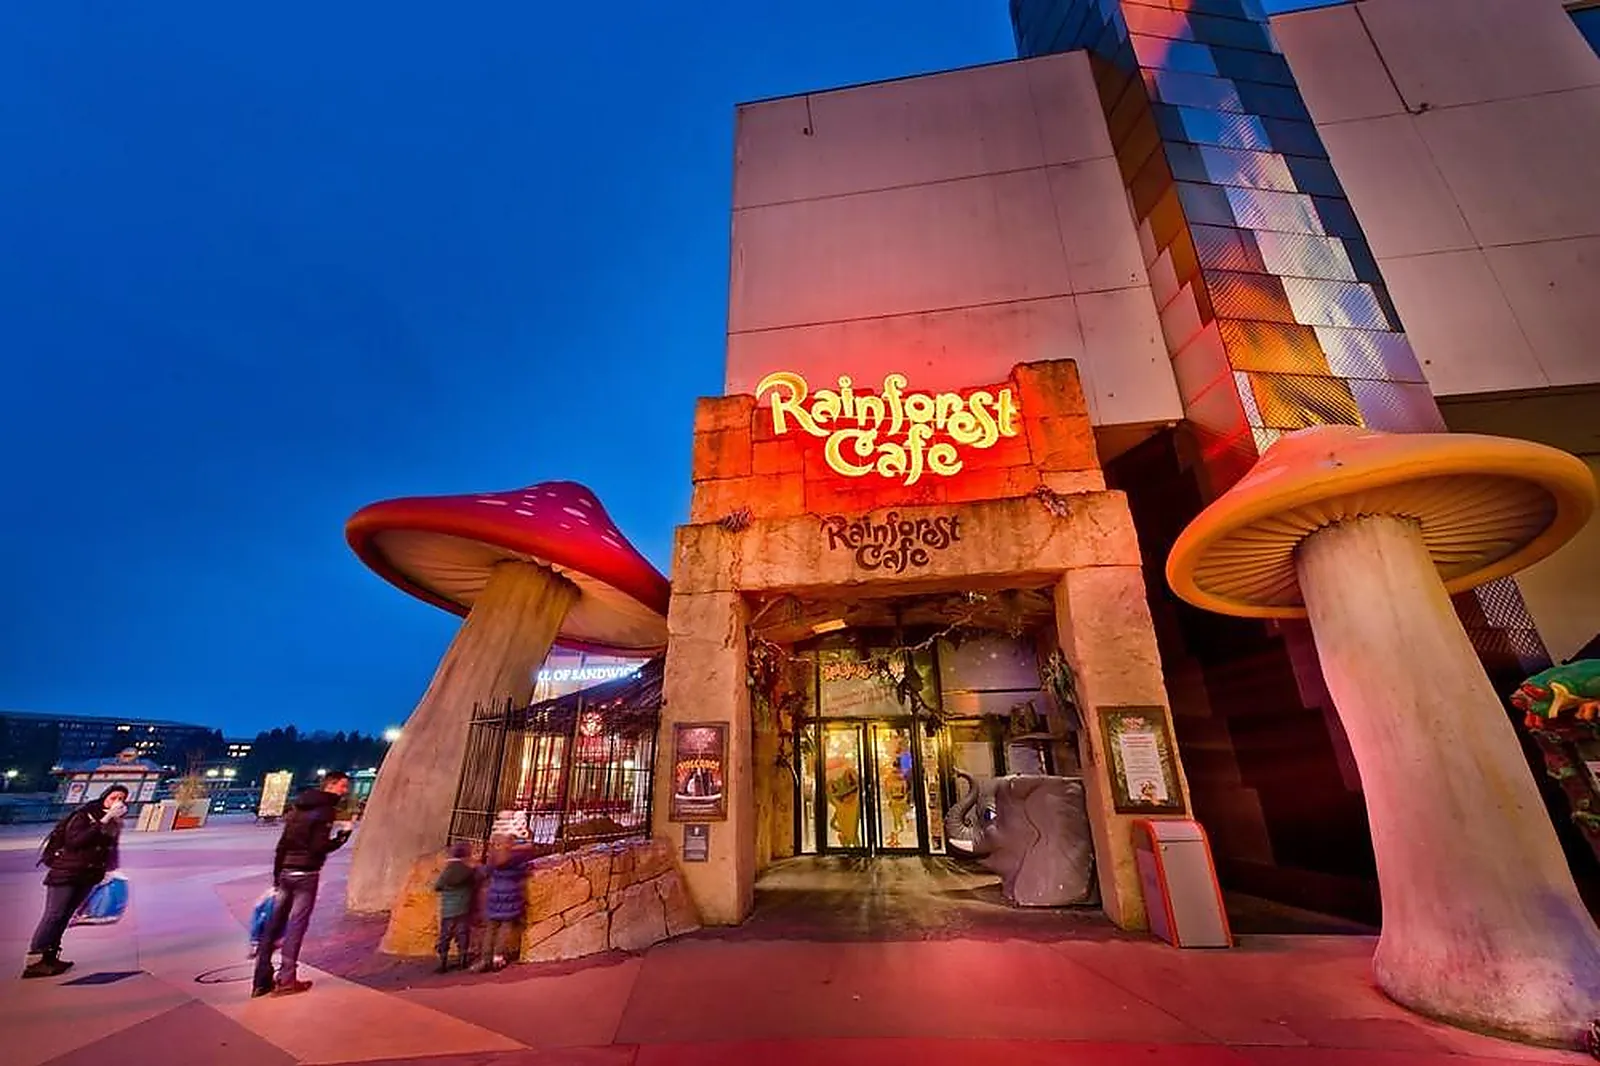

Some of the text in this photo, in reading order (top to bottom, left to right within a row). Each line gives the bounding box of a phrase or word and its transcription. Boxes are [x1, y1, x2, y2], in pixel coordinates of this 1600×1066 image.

[755, 371, 1019, 448] Rainforest
[824, 422, 963, 486] Cafe
[820, 511, 961, 550] Rainforest
[855, 537, 930, 574] Cafe
[553, 667, 571, 681] OF
